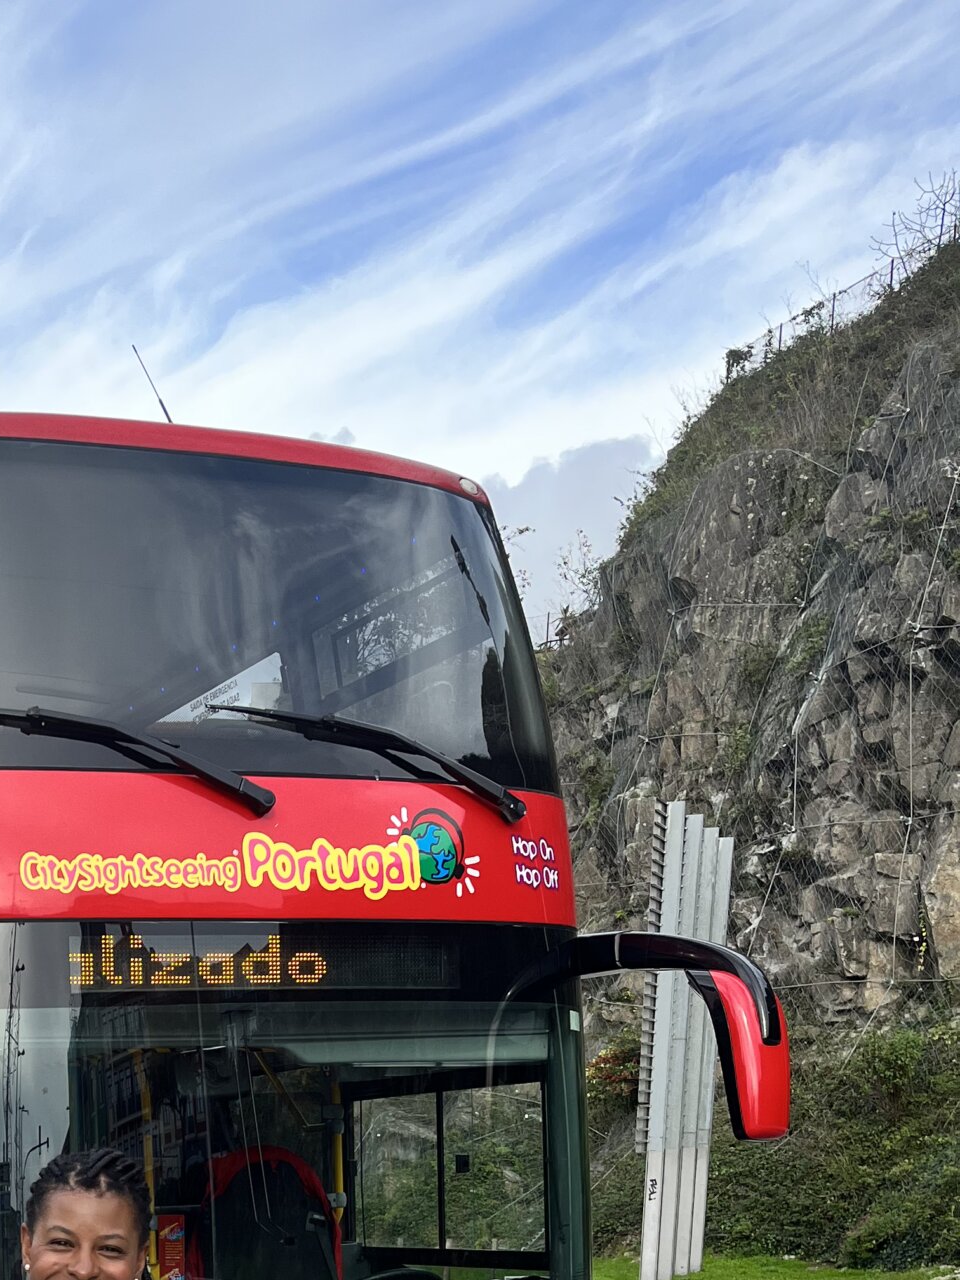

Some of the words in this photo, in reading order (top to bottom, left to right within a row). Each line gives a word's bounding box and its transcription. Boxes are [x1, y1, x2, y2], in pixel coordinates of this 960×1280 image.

[512, 835, 537, 860] Hop
[540, 838, 555, 861] On
[20, 851, 242, 895] CitySightseeing
[242, 831, 421, 901] Portugal
[515, 864, 541, 888] Hop
[543, 866, 559, 889] Off
